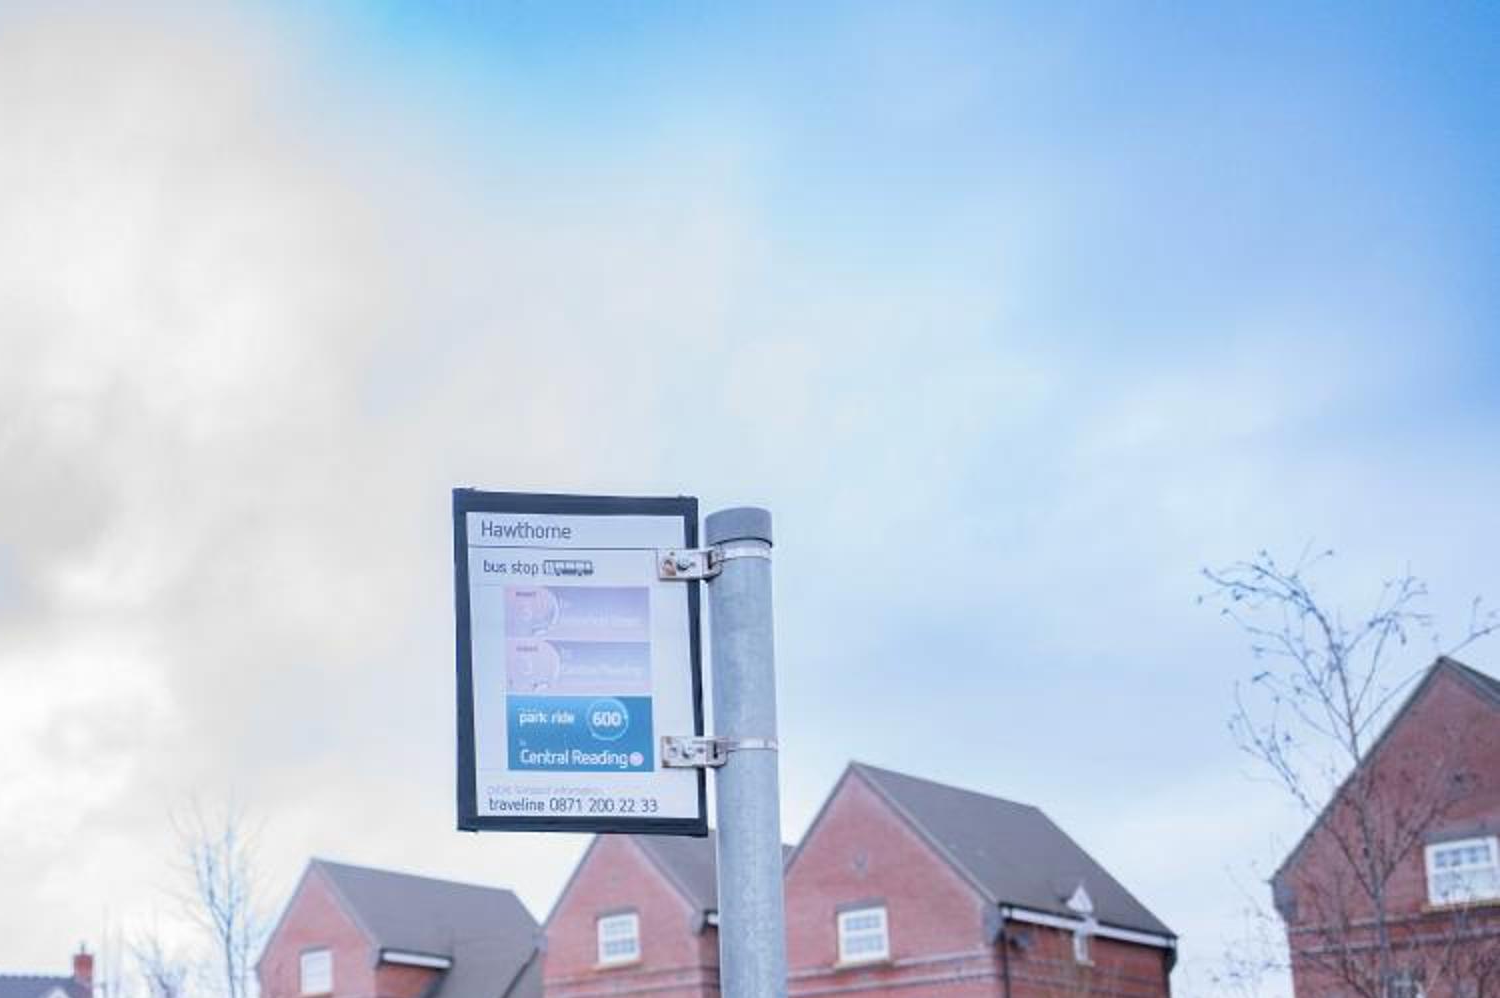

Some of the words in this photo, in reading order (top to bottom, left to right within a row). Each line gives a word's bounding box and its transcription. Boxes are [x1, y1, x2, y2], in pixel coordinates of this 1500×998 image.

[481, 520, 571, 539] Hawthorne
[483, 559, 506, 573] bus
[511, 560, 538, 577] stop
[519, 710, 548, 726] park
[551, 709, 575, 724] ride
[592, 711, 622, 727] 600
[521, 749, 569, 764] Central
[571, 749, 628, 769] Reading
[489, 797, 545, 812] traveline
[549, 798, 582, 812] 0871
[588, 799, 615, 812] 200
[619, 799, 635, 813] 22
[641, 799, 659, 813] 33
